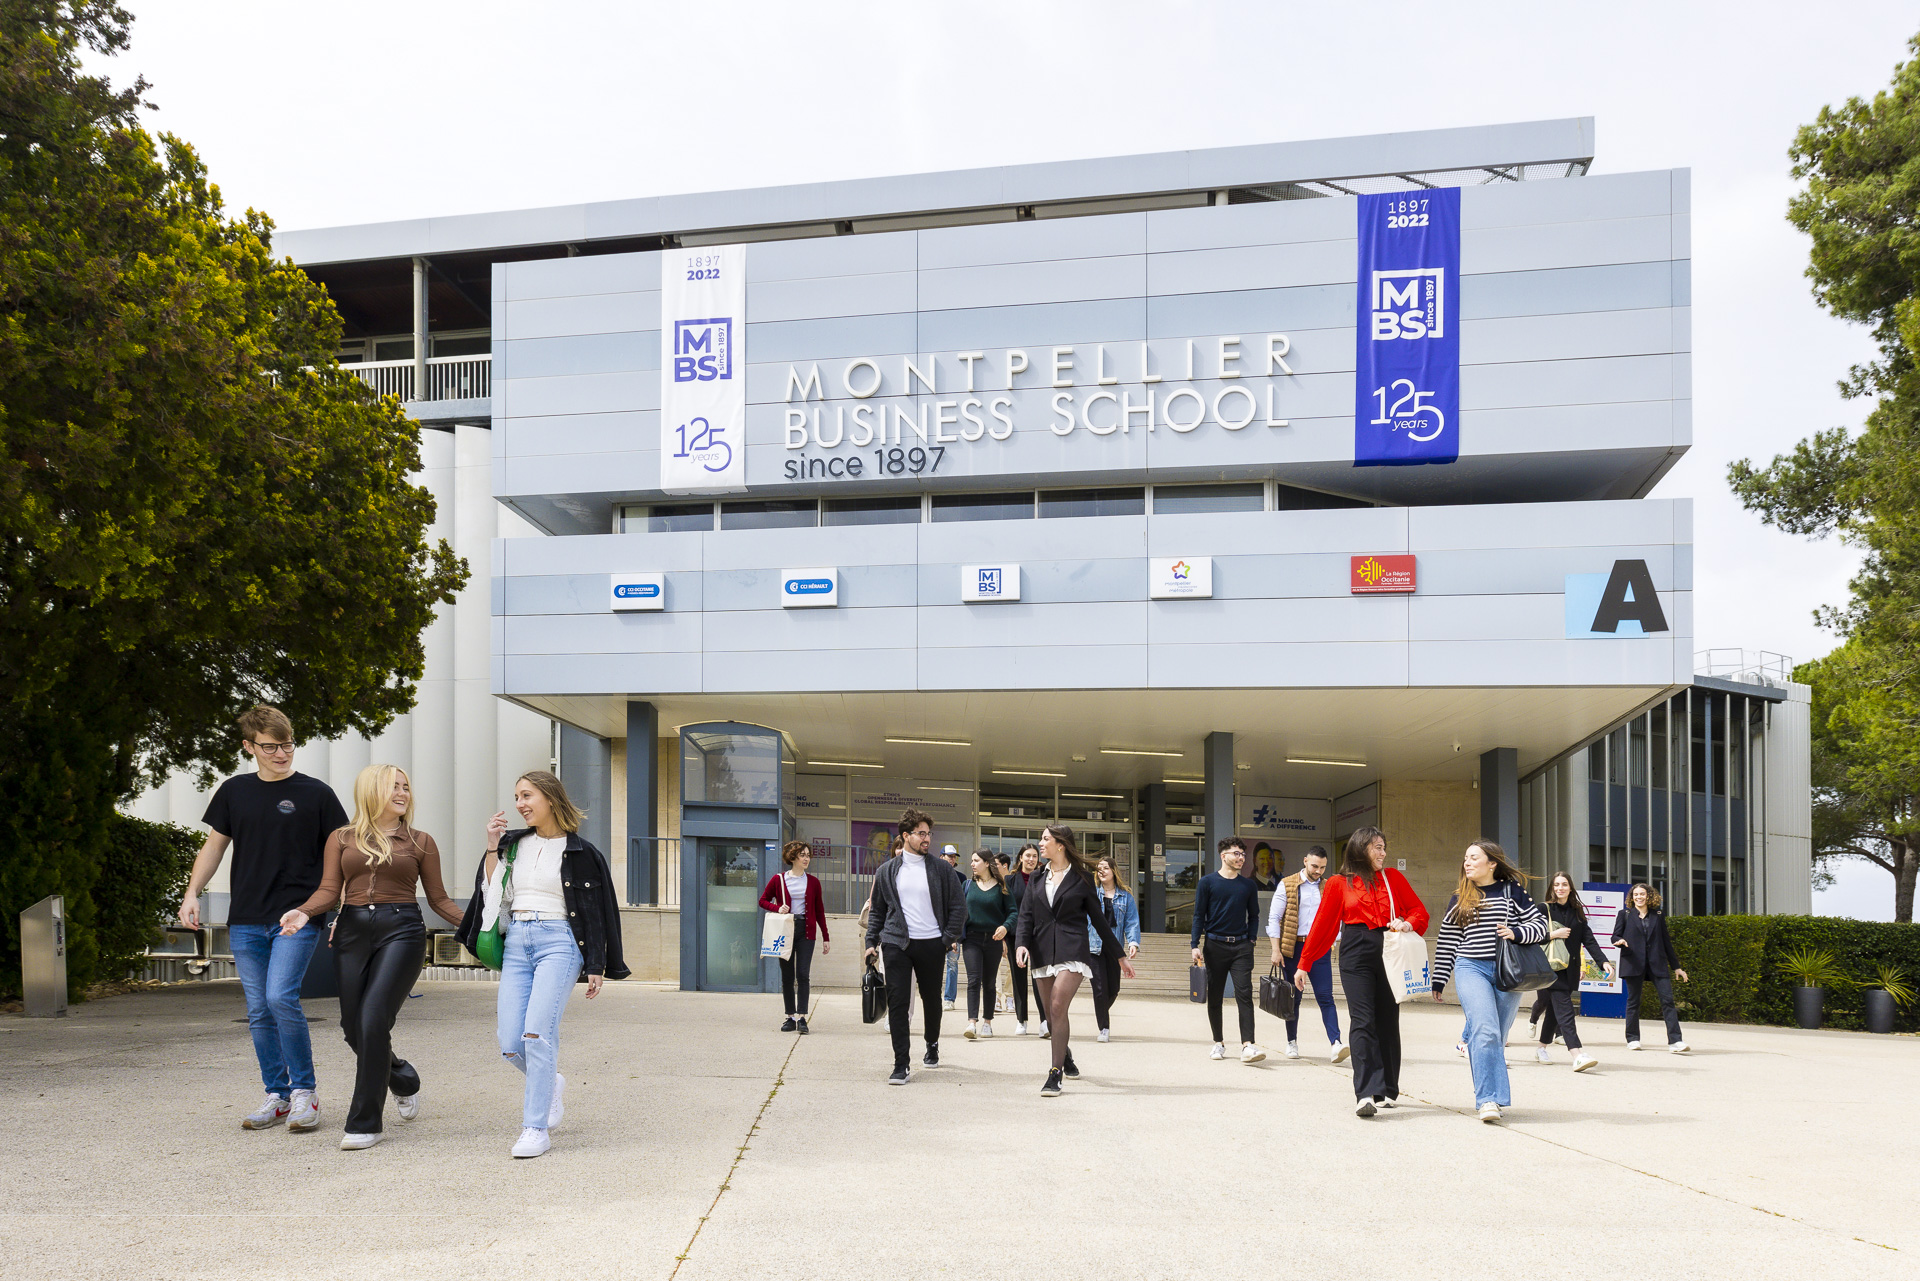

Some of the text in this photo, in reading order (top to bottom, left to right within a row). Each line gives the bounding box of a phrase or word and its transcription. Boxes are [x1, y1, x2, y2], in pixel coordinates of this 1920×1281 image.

[1388, 199, 1429, 214] 1897
[1387, 214, 1429, 228] 2022
[687, 255, 720, 268] 1897
[687, 269, 720, 281] 2022
[1382, 279, 1419, 310] M
[1425, 279, 1434, 328] since 1897
[1371, 309, 1427, 341] BS
[683, 328, 711, 354] M
[674, 355, 719, 383] BS
[784, 333, 1294, 402] MONTPELLIER
[784, 384, 1290, 451] BUSINESS SCHOOL
[1370, 378, 1445, 442] 125
[1392, 418, 1428, 431] years
[673, 416, 732, 472] 125
[691, 452, 720, 464] years
[784, 446, 946, 480] since 1897
[979, 582, 996, 592] BS
[982, 572, 994, 582] M
[1590, 559, 1669, 633] A
